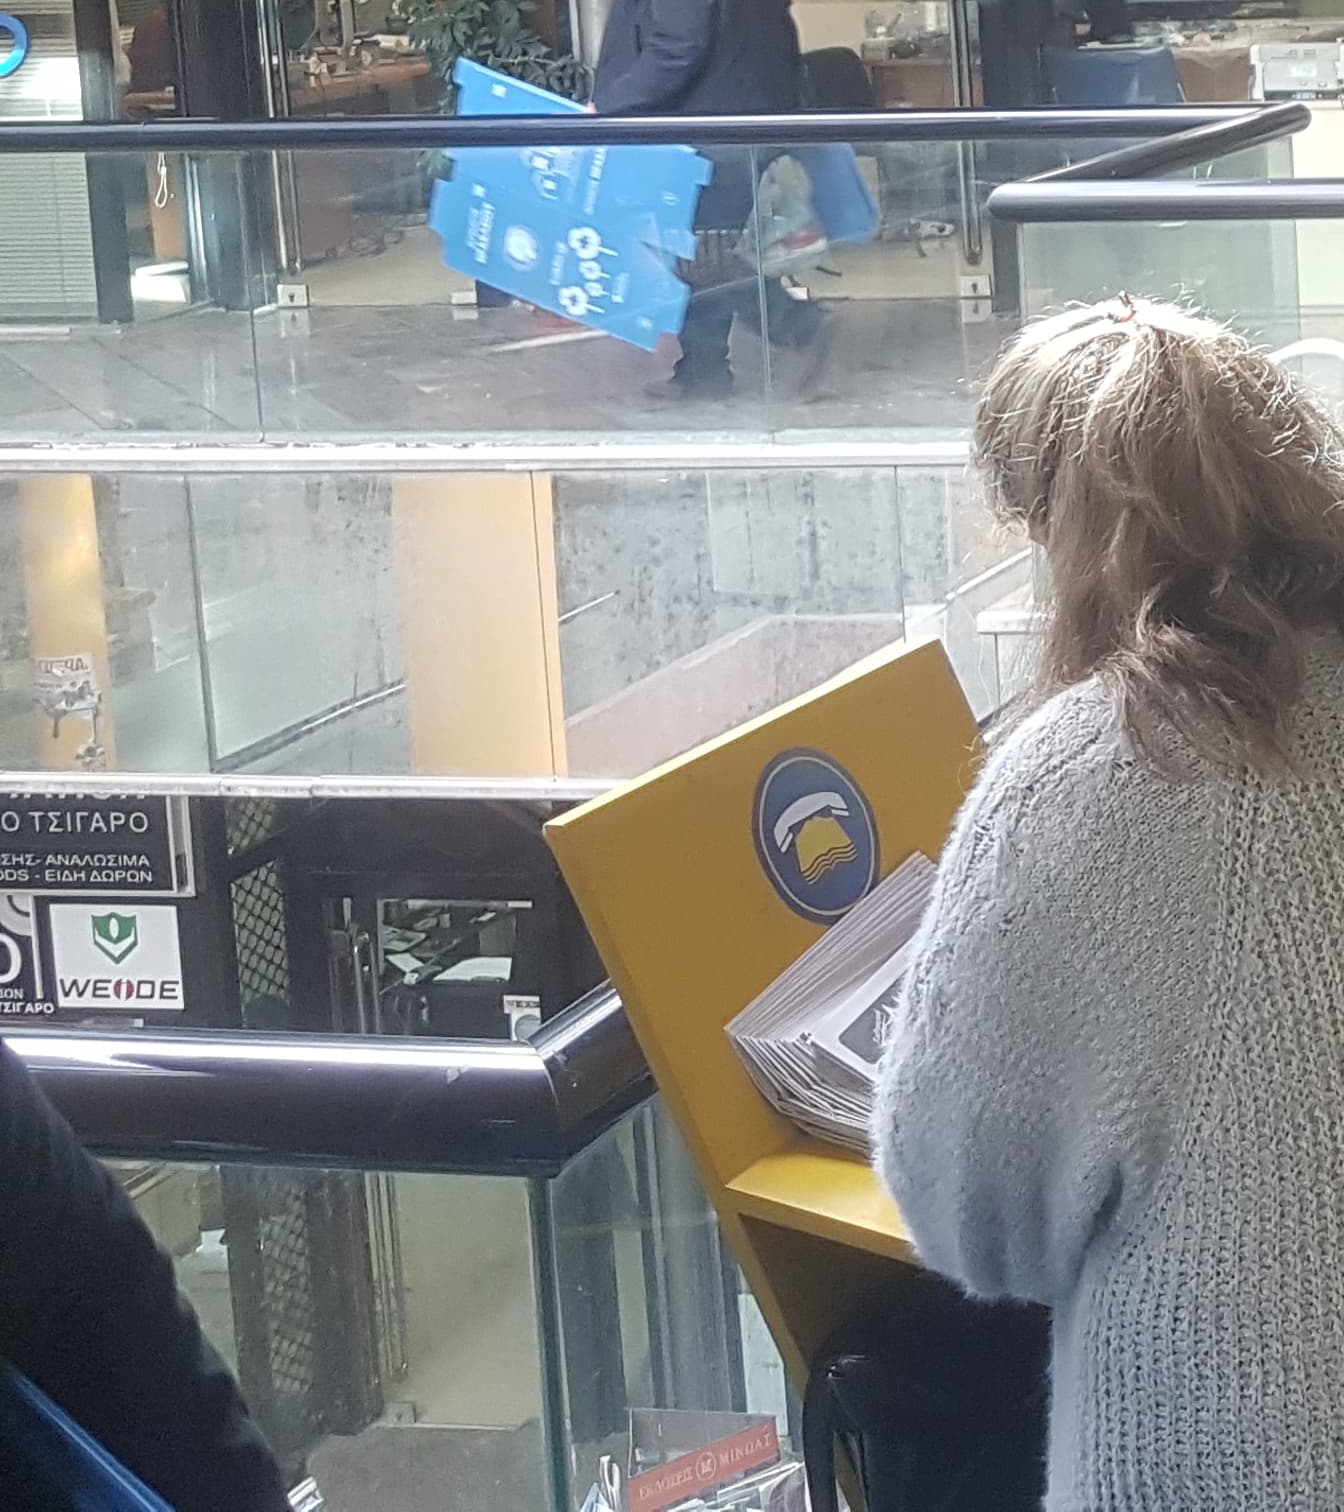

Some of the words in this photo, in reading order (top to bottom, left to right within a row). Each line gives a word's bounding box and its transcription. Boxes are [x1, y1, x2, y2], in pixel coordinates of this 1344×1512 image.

[1, 811, 20, 832] Ο
[27, 811, 149, 833] ΤΣΙΓΑΡΟ
[44, 854, 150, 867] ΑΝΑΛΩΣΙΜΑ
[45, 869, 87, 881] ΕΙΔΗ
[89, 869, 153, 883] ΔΩΡΩΝ
